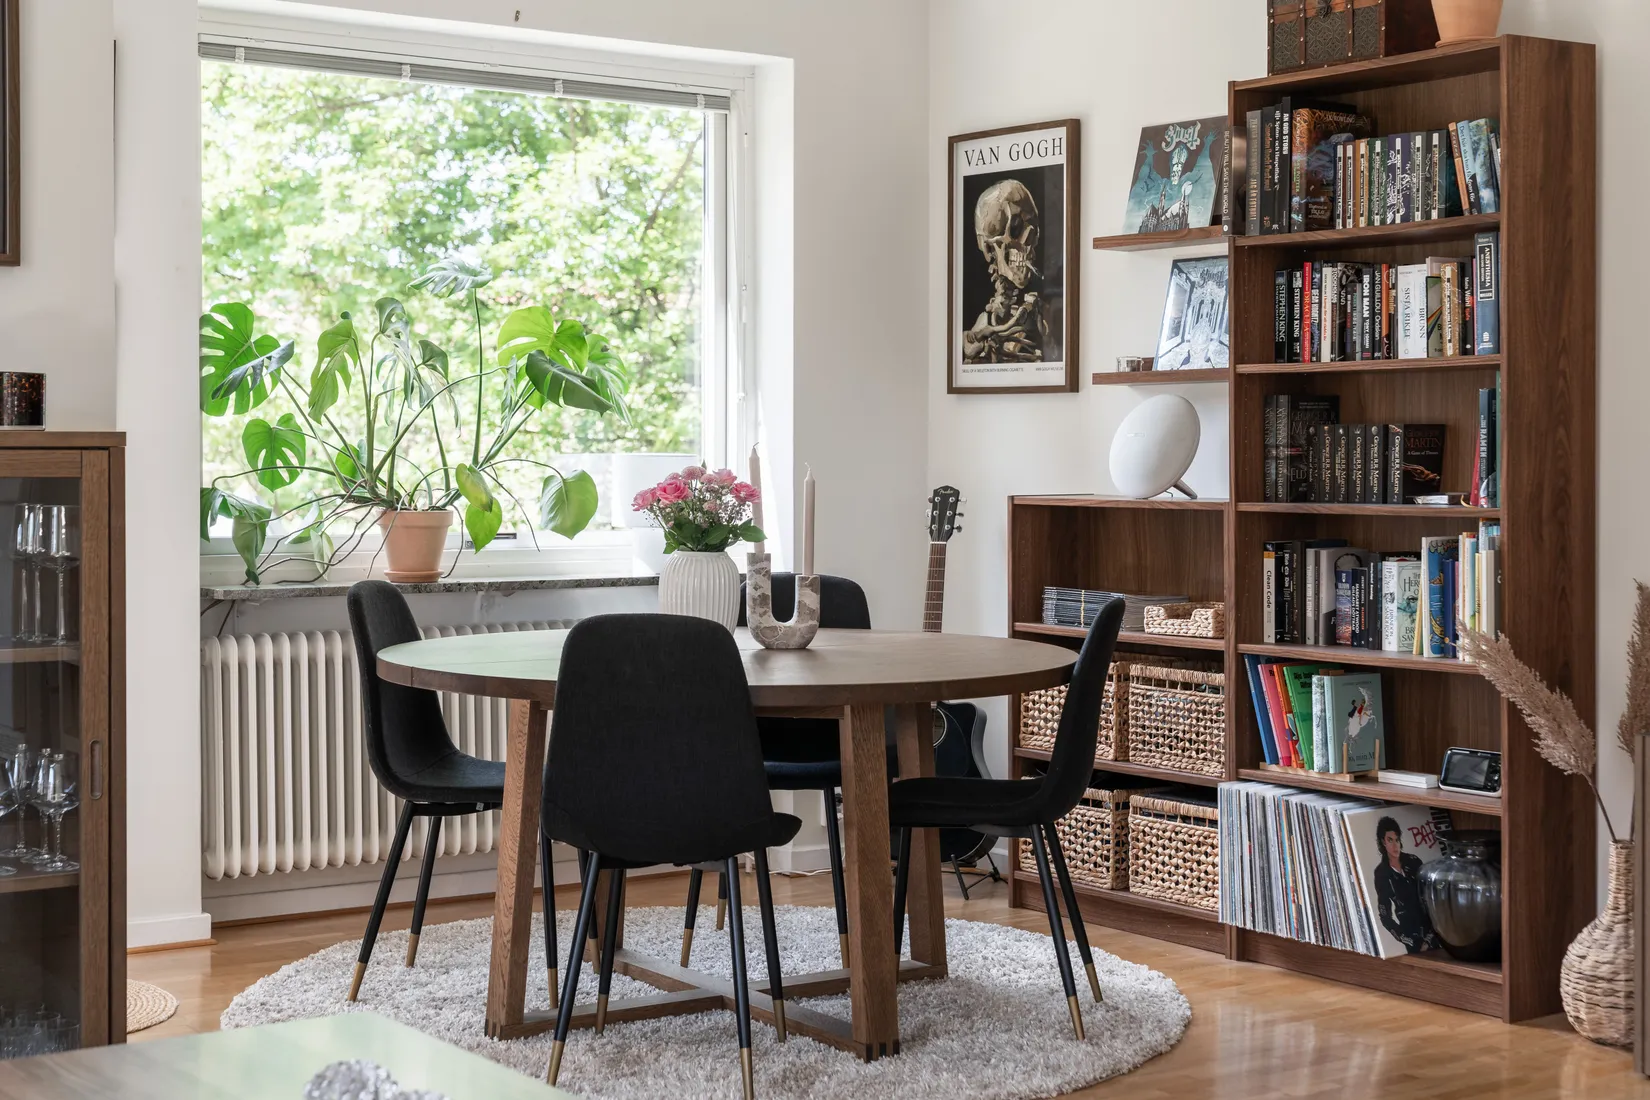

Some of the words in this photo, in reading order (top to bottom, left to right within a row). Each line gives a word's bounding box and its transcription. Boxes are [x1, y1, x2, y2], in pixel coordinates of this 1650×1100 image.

[1282, 113, 1289, 122] AN
[1162, 120, 1201, 152] Ghost
[964, 146, 1000, 167] VAN
[1009, 138, 1063, 162] GOGH
[1405, 437, 1441, 448] MARTIN
[1407, 820, 1437, 849] BAD
